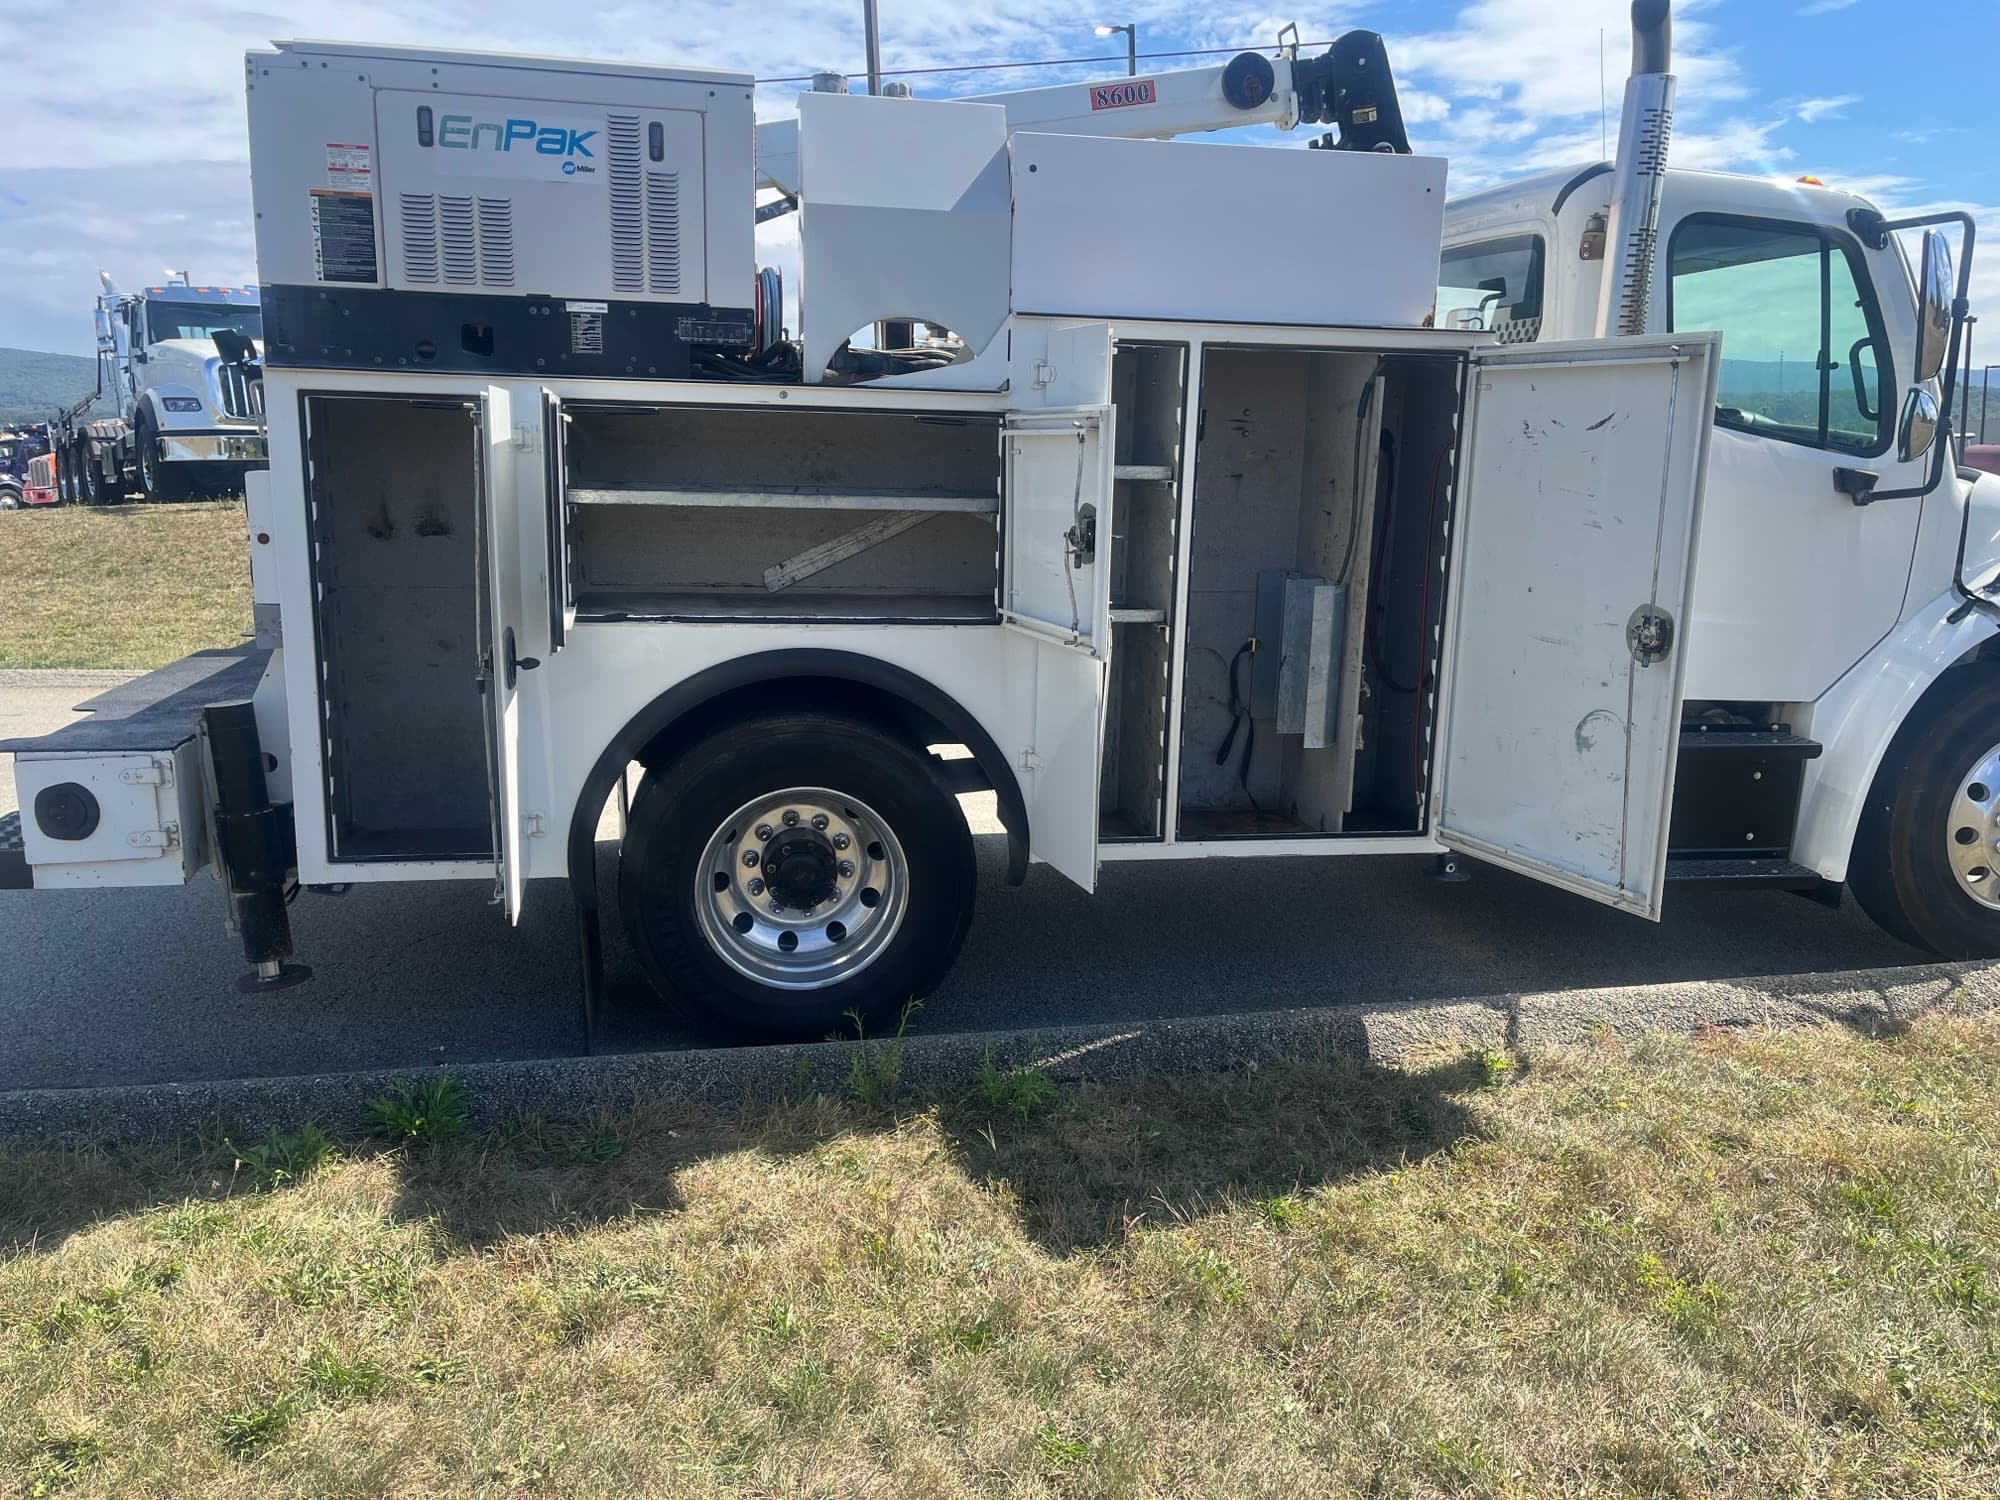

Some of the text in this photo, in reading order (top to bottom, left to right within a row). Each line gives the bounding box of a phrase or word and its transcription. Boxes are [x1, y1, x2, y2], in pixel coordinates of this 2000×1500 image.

[1096, 83, 1150, 107] 8600
[438, 114, 600, 158] EnPak
[576, 165, 596, 174] Miller
